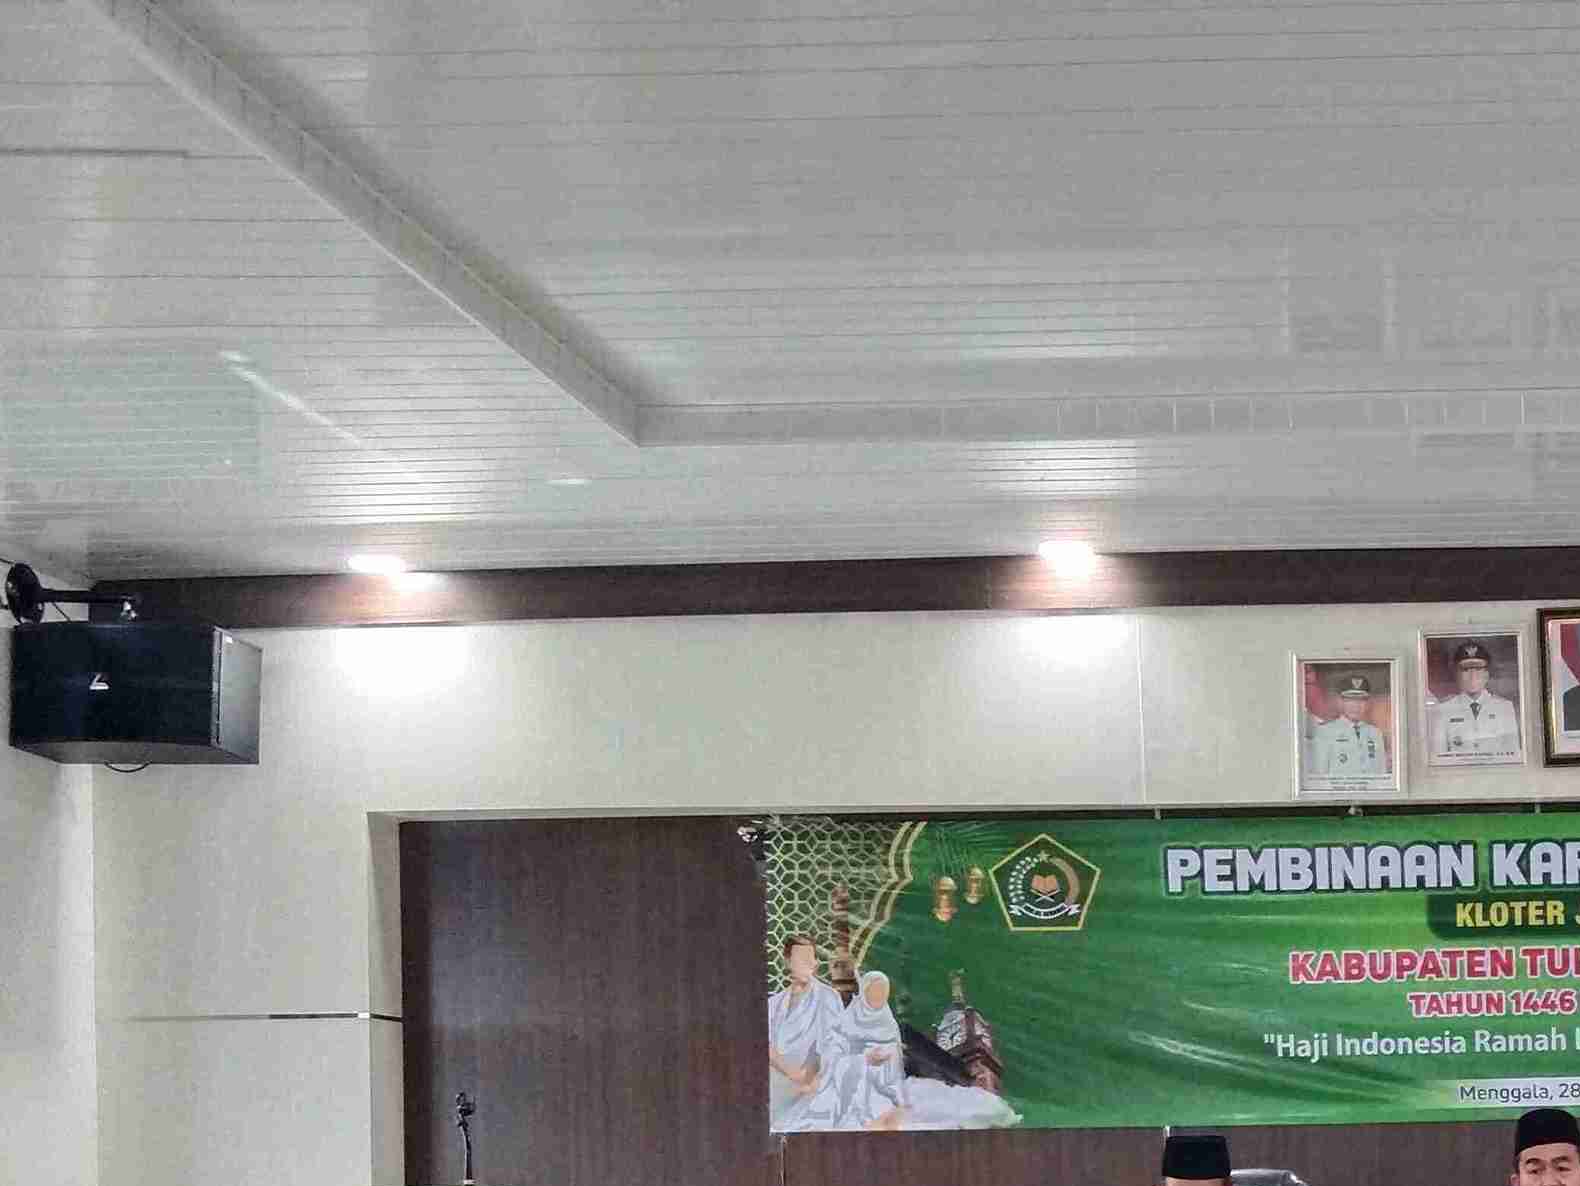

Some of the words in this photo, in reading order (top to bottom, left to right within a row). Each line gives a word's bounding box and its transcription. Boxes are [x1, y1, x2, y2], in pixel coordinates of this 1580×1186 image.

[1166, 844, 1475, 893] PEMBINAAN
[1455, 901, 1566, 927] KLOTER
[1289, 948, 1515, 984] KABUPATEN
[1408, 991, 1505, 1017] TAHUN
[1511, 988, 1576, 1015] 1446
[1265, 1033, 1328, 1063] "Haji
[1336, 1030, 1466, 1055] Indonesia
[1475, 1025, 1567, 1052] Ramah
[1459, 1085, 1554, 1104] Menggala,
